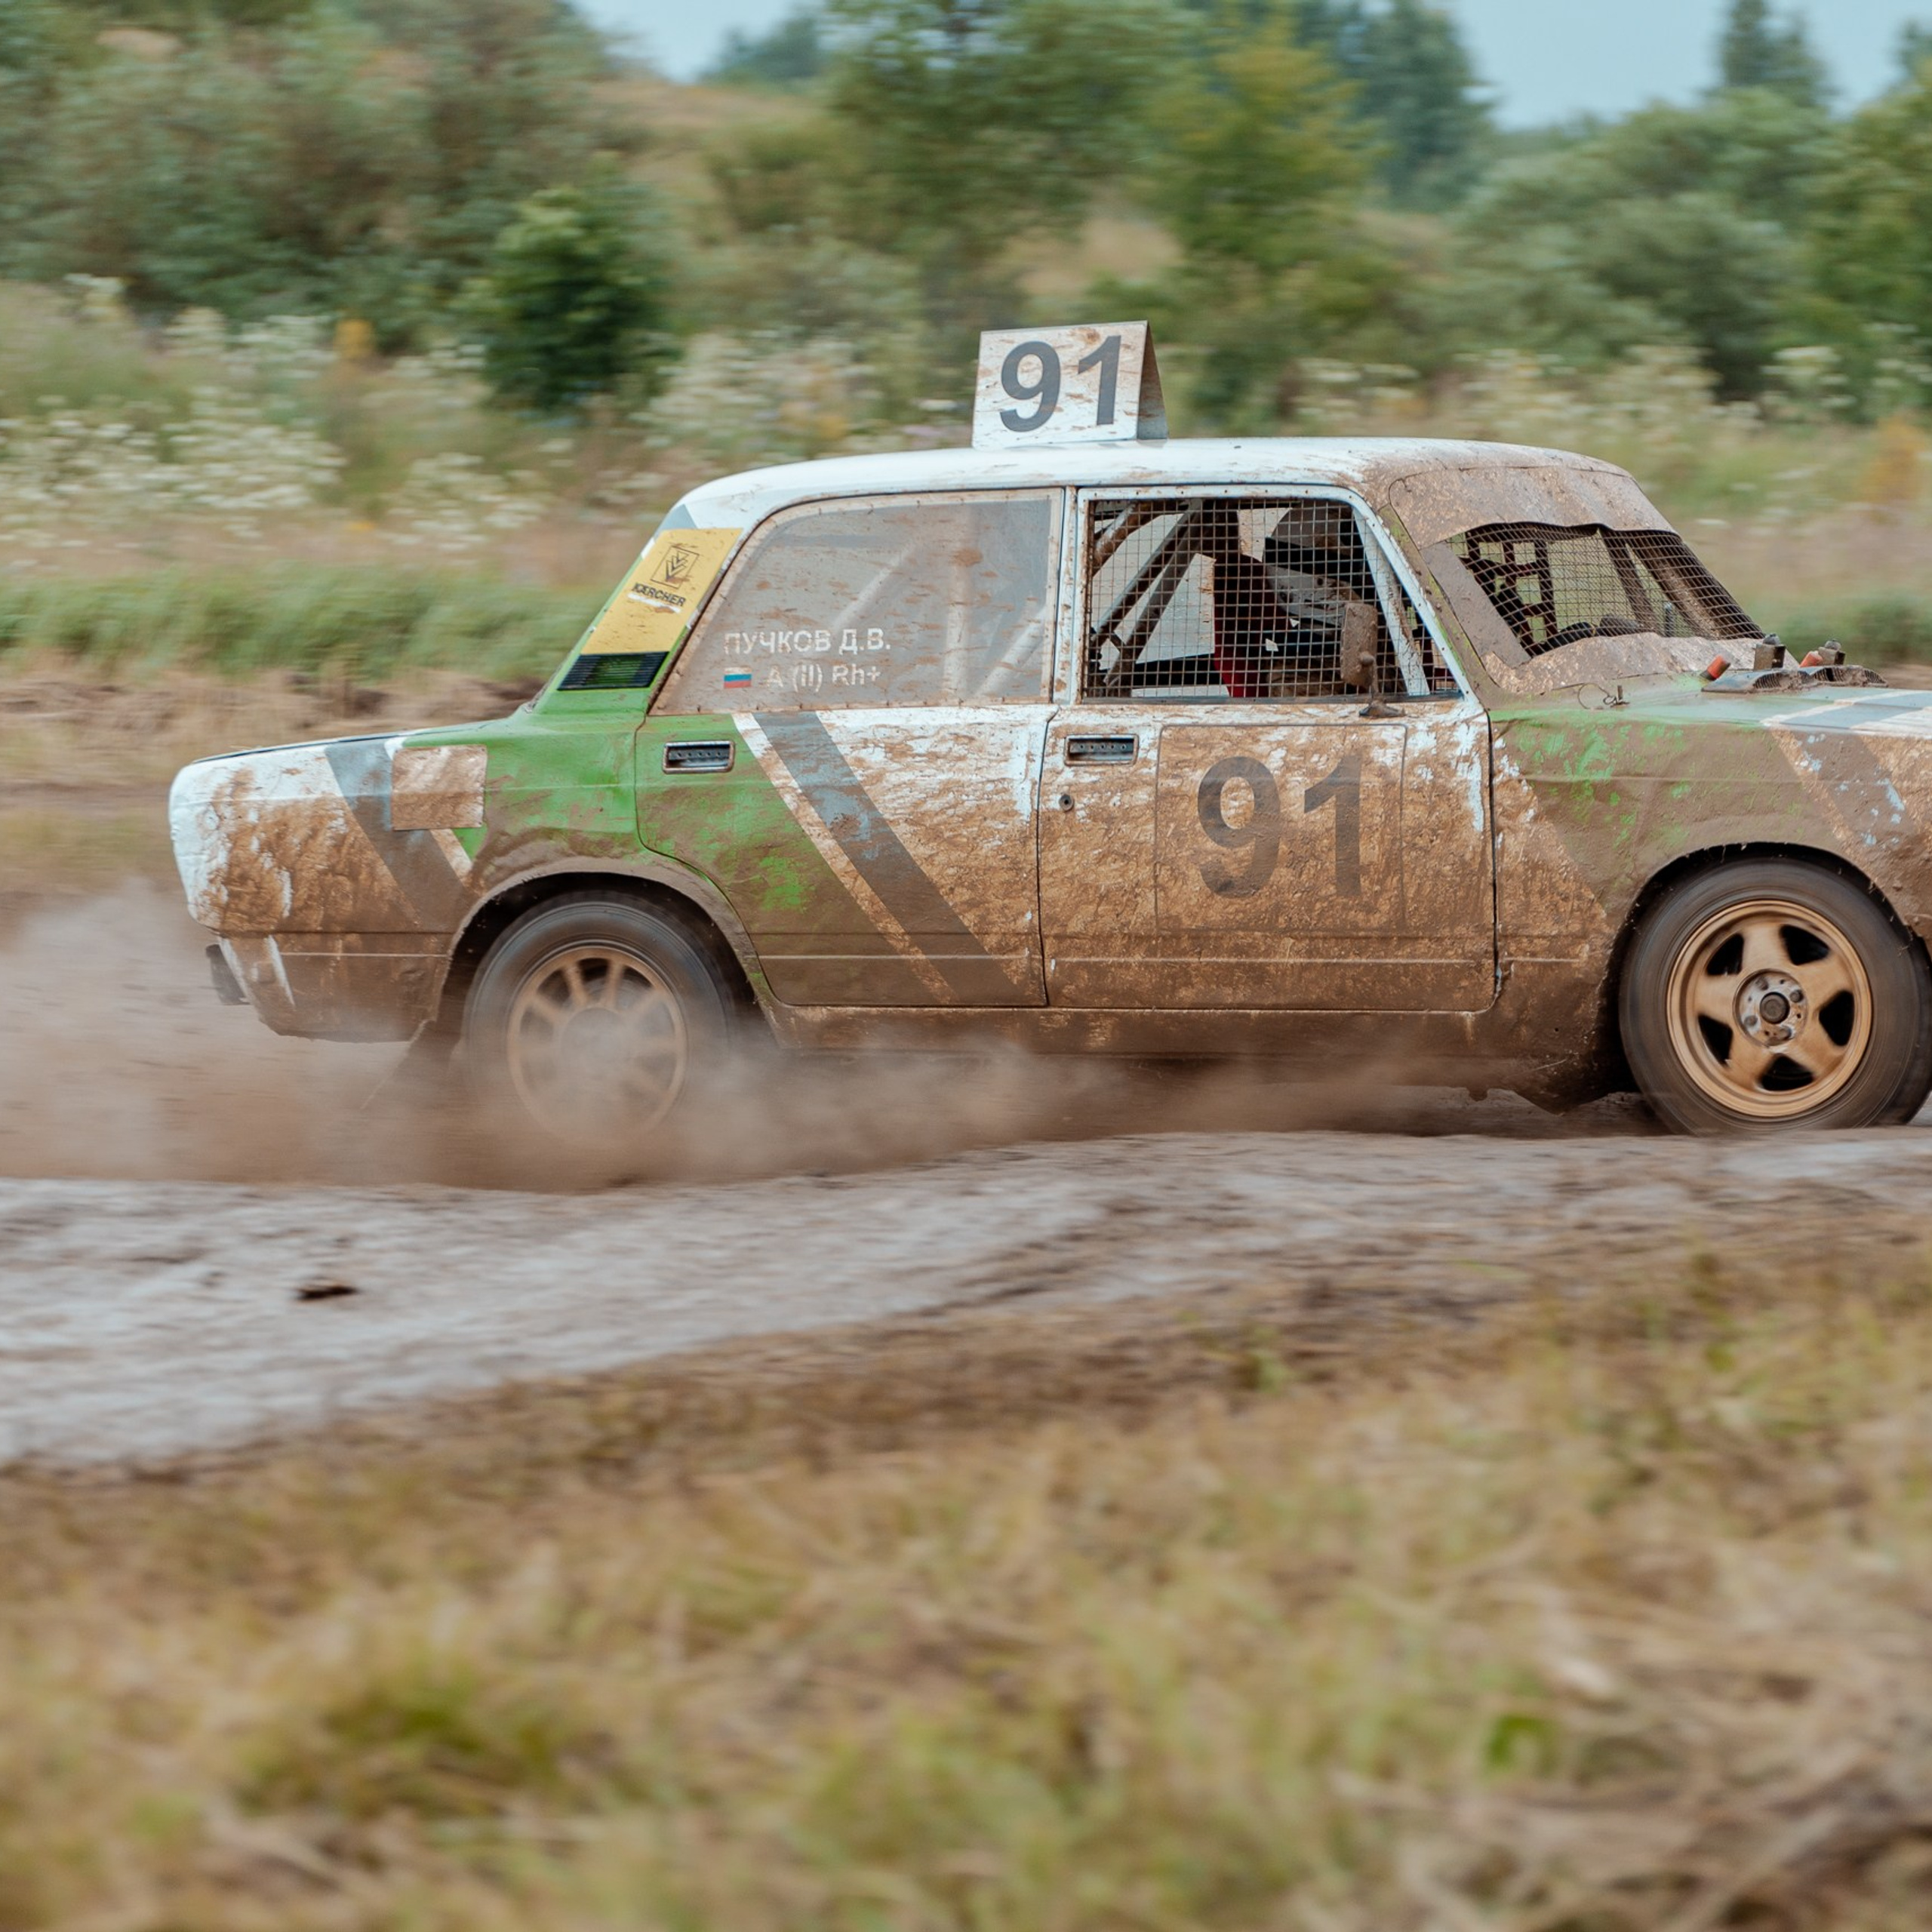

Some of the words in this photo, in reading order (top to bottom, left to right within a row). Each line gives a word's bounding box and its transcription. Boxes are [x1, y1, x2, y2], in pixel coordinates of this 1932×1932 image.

[999, 334, 1121, 432] 91
[724, 629, 831, 654] ПУЧКОВ
[838, 628, 891, 655] Д.В.
[832, 663, 881, 685] Rh+
[1197, 749, 1361, 899] 91
